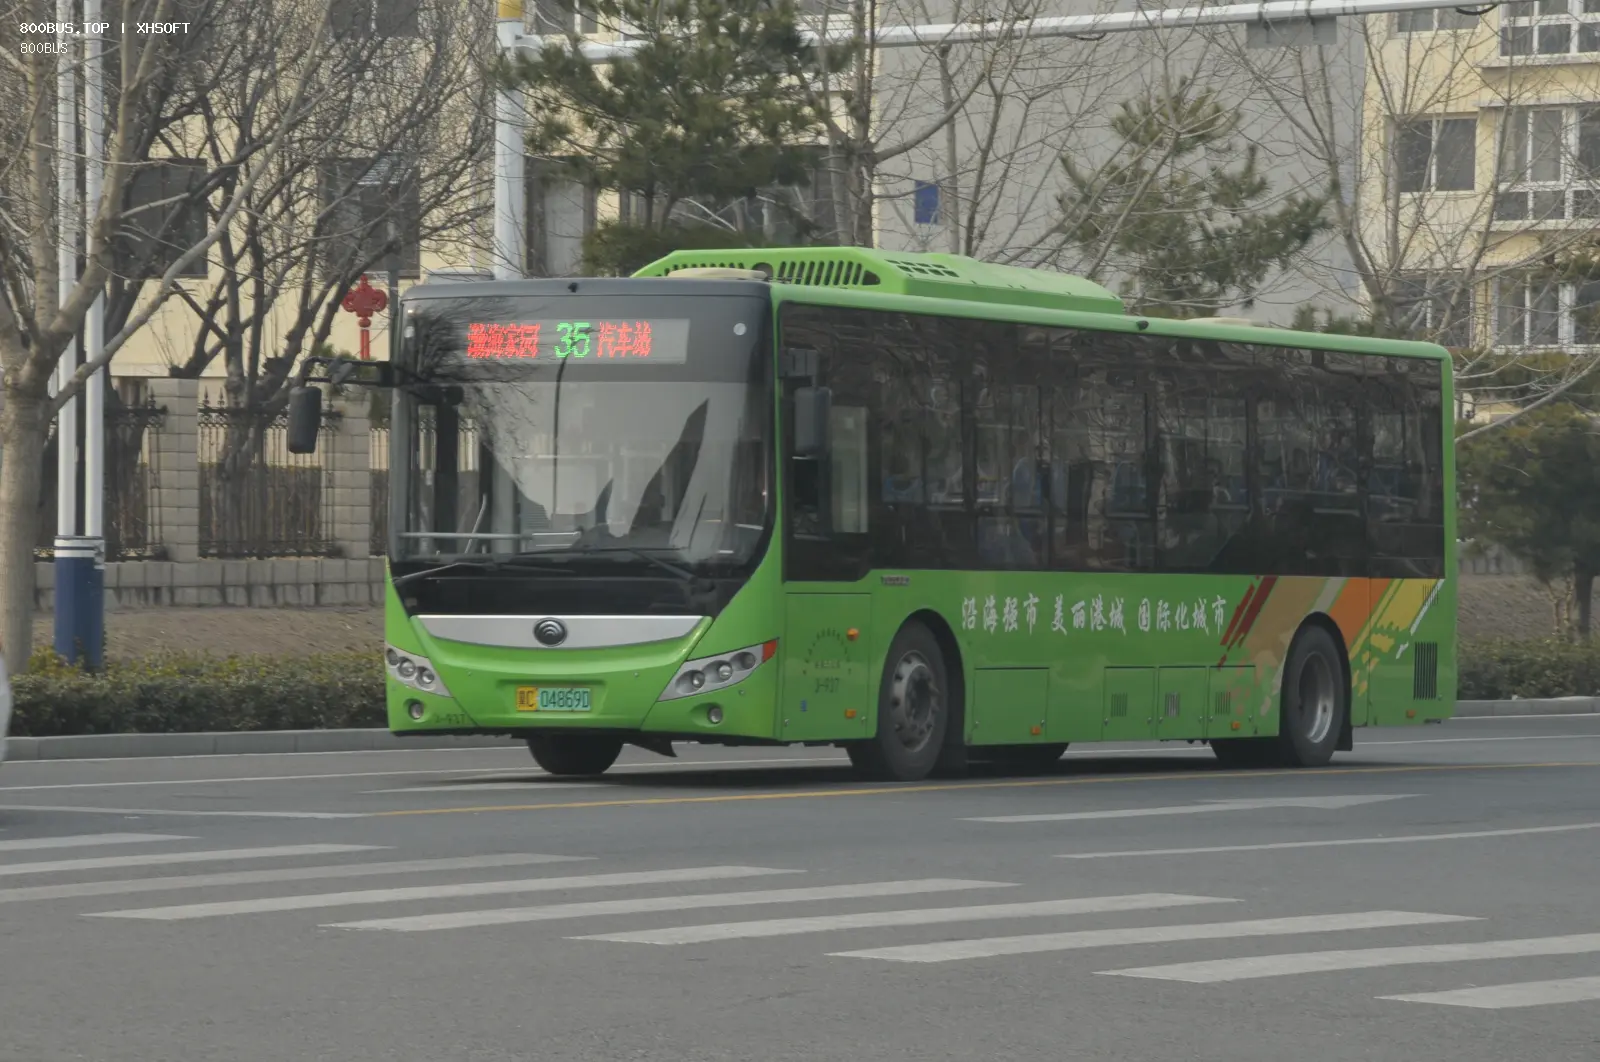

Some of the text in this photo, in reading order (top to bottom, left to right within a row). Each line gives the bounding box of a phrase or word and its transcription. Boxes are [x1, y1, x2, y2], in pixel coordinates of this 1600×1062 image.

[554, 321, 591, 358] 35
[597, 320, 651, 358] 汽车站
[961, 592, 1227, 636] 沿海强市 美丽港城 国际化城市
